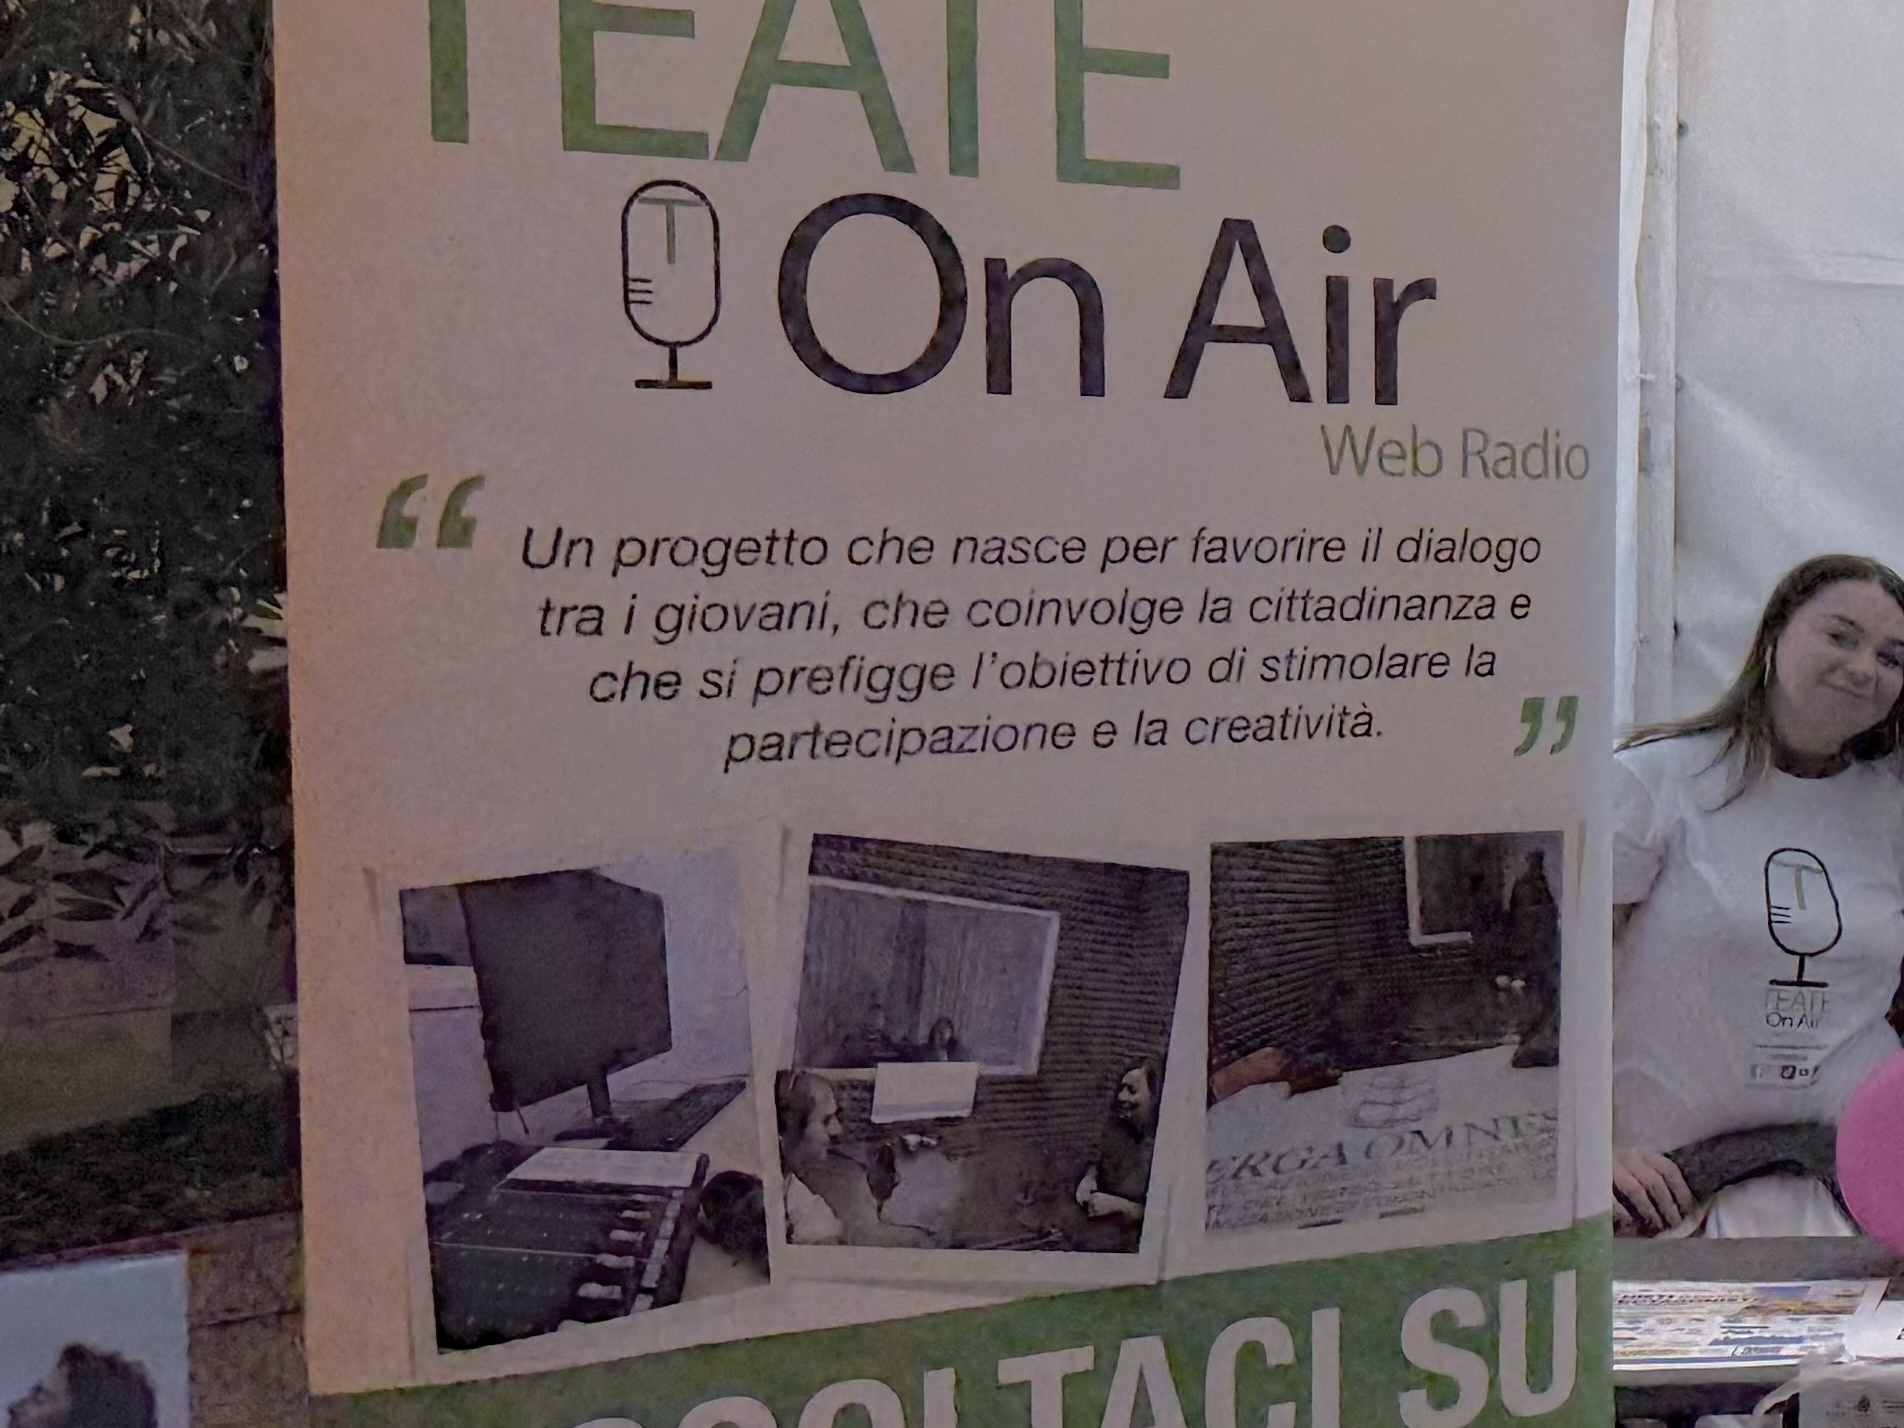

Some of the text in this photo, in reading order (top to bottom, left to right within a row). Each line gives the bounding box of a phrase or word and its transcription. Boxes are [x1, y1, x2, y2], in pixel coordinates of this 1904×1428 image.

[778, 193, 1437, 405] On Air
[1320, 422, 1591, 481] Web Radio
[522, 528, 1542, 578] Un progetto che nasce per favorire dialogo
[540, 587, 1496, 646] tra giovani, che coinvolge la cittadinanza
[590, 660, 682, 704] che
[700, 658, 737, 700] si
[753, 652, 955, 706] prefigge
[1208, 647, 1245, 685] di
[1260, 644, 1450, 683] stimolare
[1463, 643, 1497, 679] la
[725, 706, 1383, 772] partecipazione la creatività.
